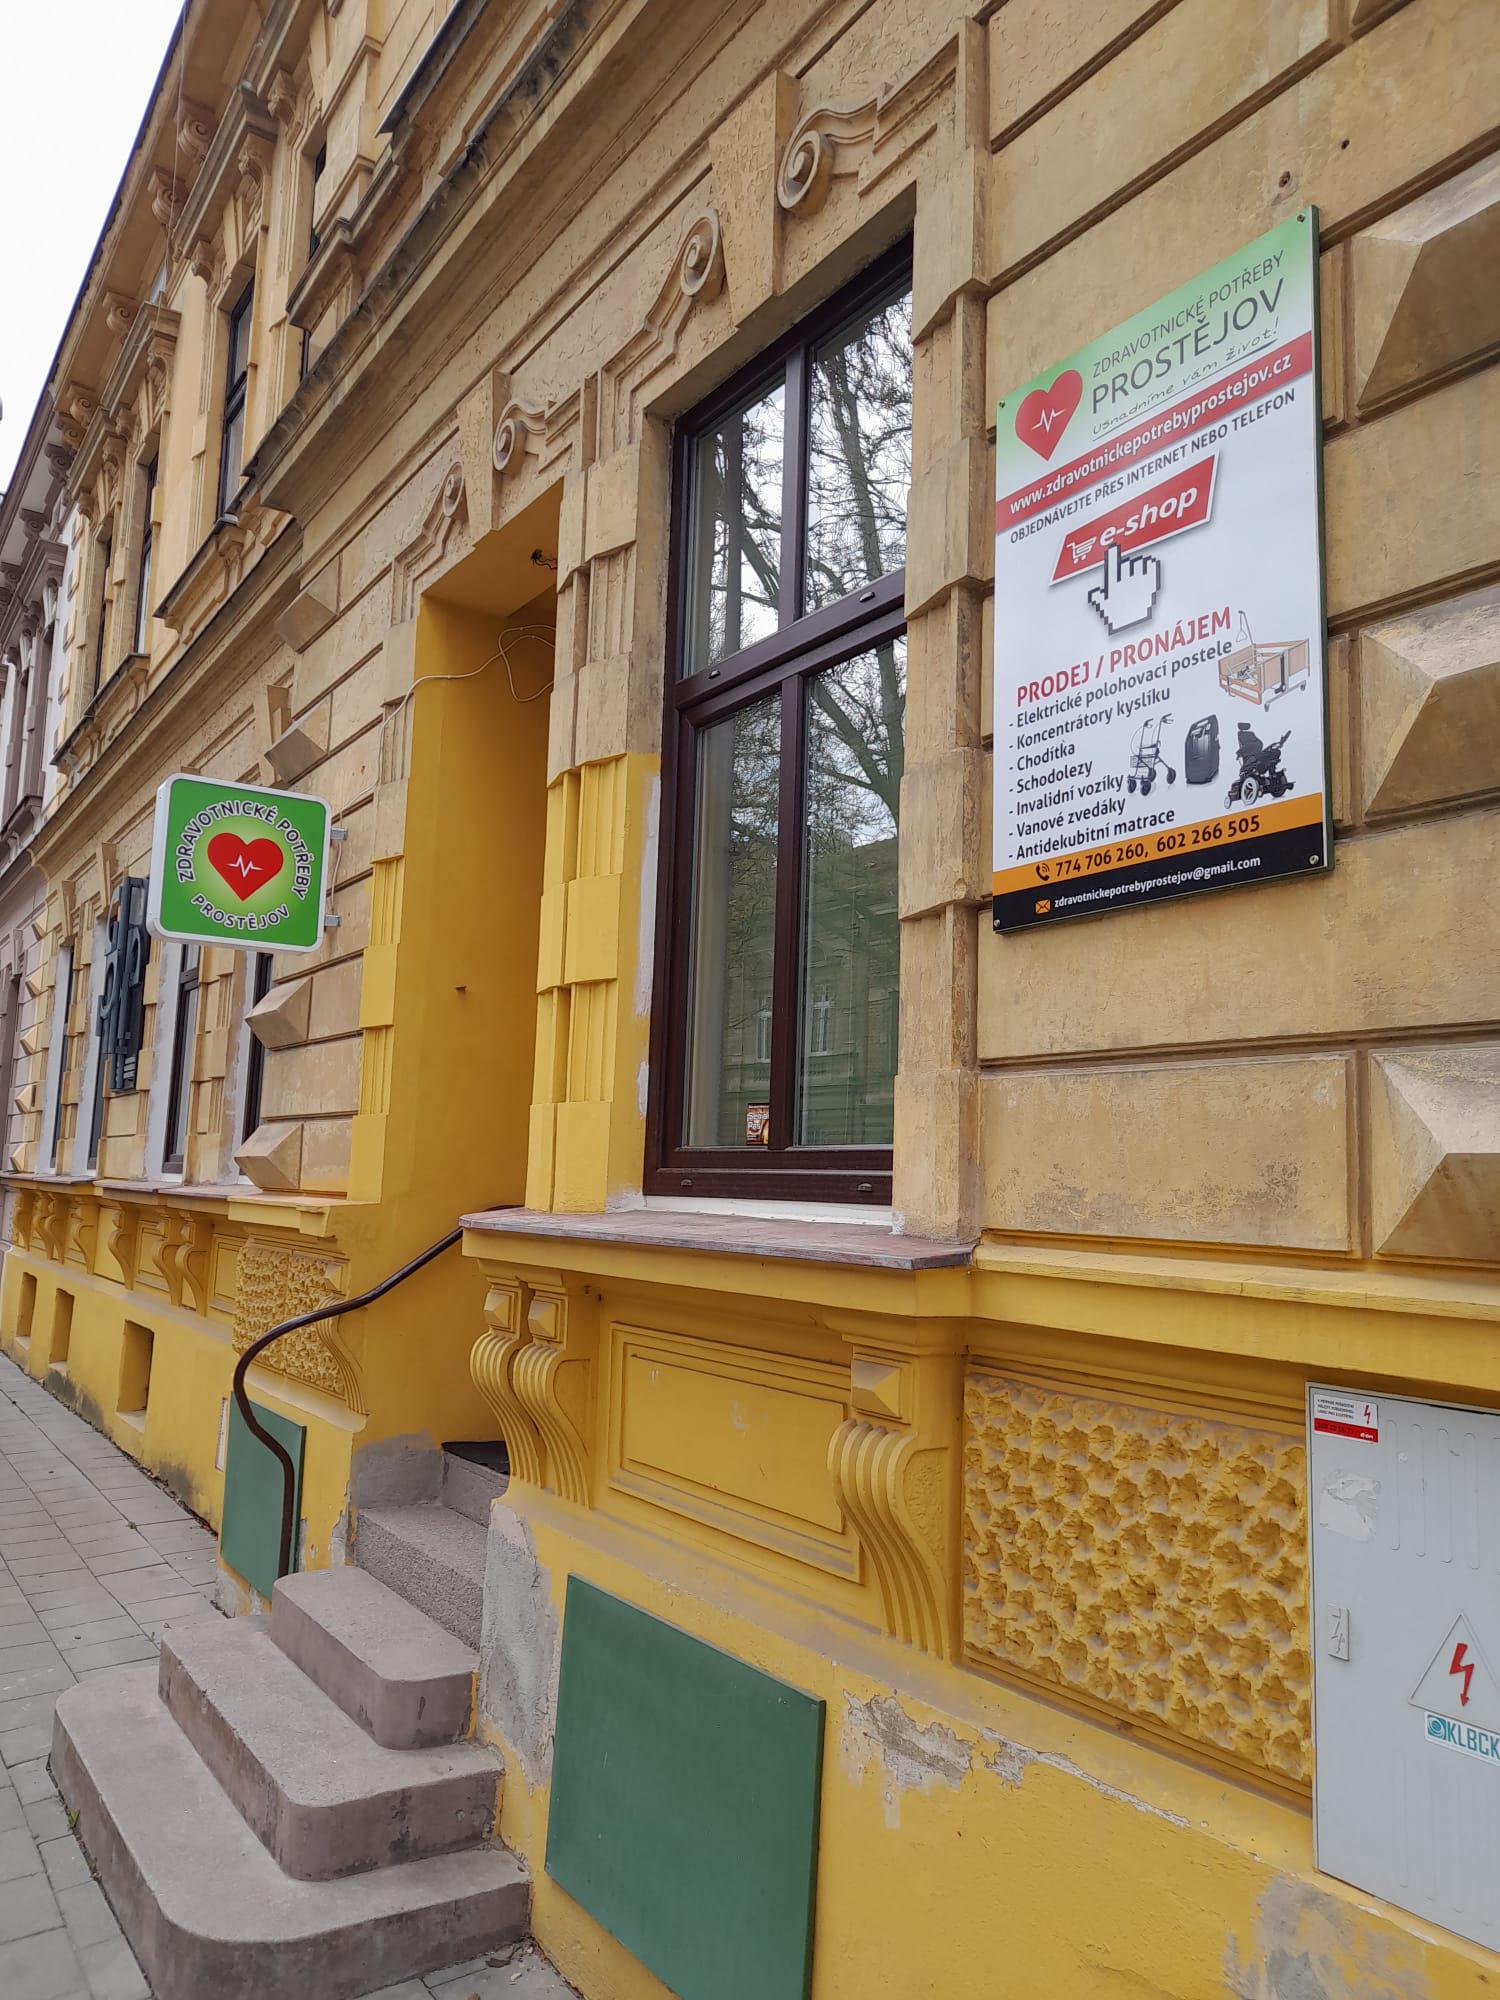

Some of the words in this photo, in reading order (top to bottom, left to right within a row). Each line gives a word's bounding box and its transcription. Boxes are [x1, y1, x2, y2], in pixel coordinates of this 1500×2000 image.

[1093, 295, 1204, 378] ZDRAVOTNICKÉ
[1209, 250, 1285, 309] POTŘEBY
[1092, 278, 1285, 414] PROSTĚJOV
[1010, 353, 1293, 515] www.zdravotnickepotrebyprostejov.cz
[1010, 492, 1092, 544] OBJEDNÁVEJTE
[1095, 476, 1124, 503] PŘES
[1127, 444, 1188, 486] INTERNET
[1191, 423, 1228, 453] NEBO
[1232, 387, 1296, 432] TELEFON
[1099, 486, 1198, 547] e-shop
[1017, 661, 1090, 707] PRODEJ
[1110, 606, 1231, 673] PRONÁJEM
[1017, 692, 1082, 728] Elektrické
[1086, 660, 1167, 708] polohovací
[1171, 640, 1232, 678] postele
[1017, 708, 1113, 750] Koncentrátory
[1117, 687, 1170, 718] kyslíku
[1016, 761, 1093, 793] Schodolezy
[1017, 742, 1075, 772] Chodítka
[1016, 787, 1075, 816] Invalidní
[1078, 775, 1124, 800] vozíky
[1016, 813, 1064, 837] Vanové
[1068, 798, 1126, 824] zvedáky
[175, 800, 279, 884] ZDRAVOTNICKÉ
[276, 817, 315, 900] POTŘEBY
[1016, 824, 1110, 861] Antidekubitní
[1114, 809, 1175, 834] matrace
[1055, 857, 1081, 877] 774
[1085, 850, 1112, 870] 706
[1116, 843, 1149, 863] 260,
[1156, 833, 1186, 852] 602
[1191, 825, 1223, 845] 266
[1227, 815, 1261, 838] 505
[191, 893, 290, 930] PROSTĚJOV
[1054, 857, 1262, 908] zdravotnickepotrebyprostejov@gmail.com
